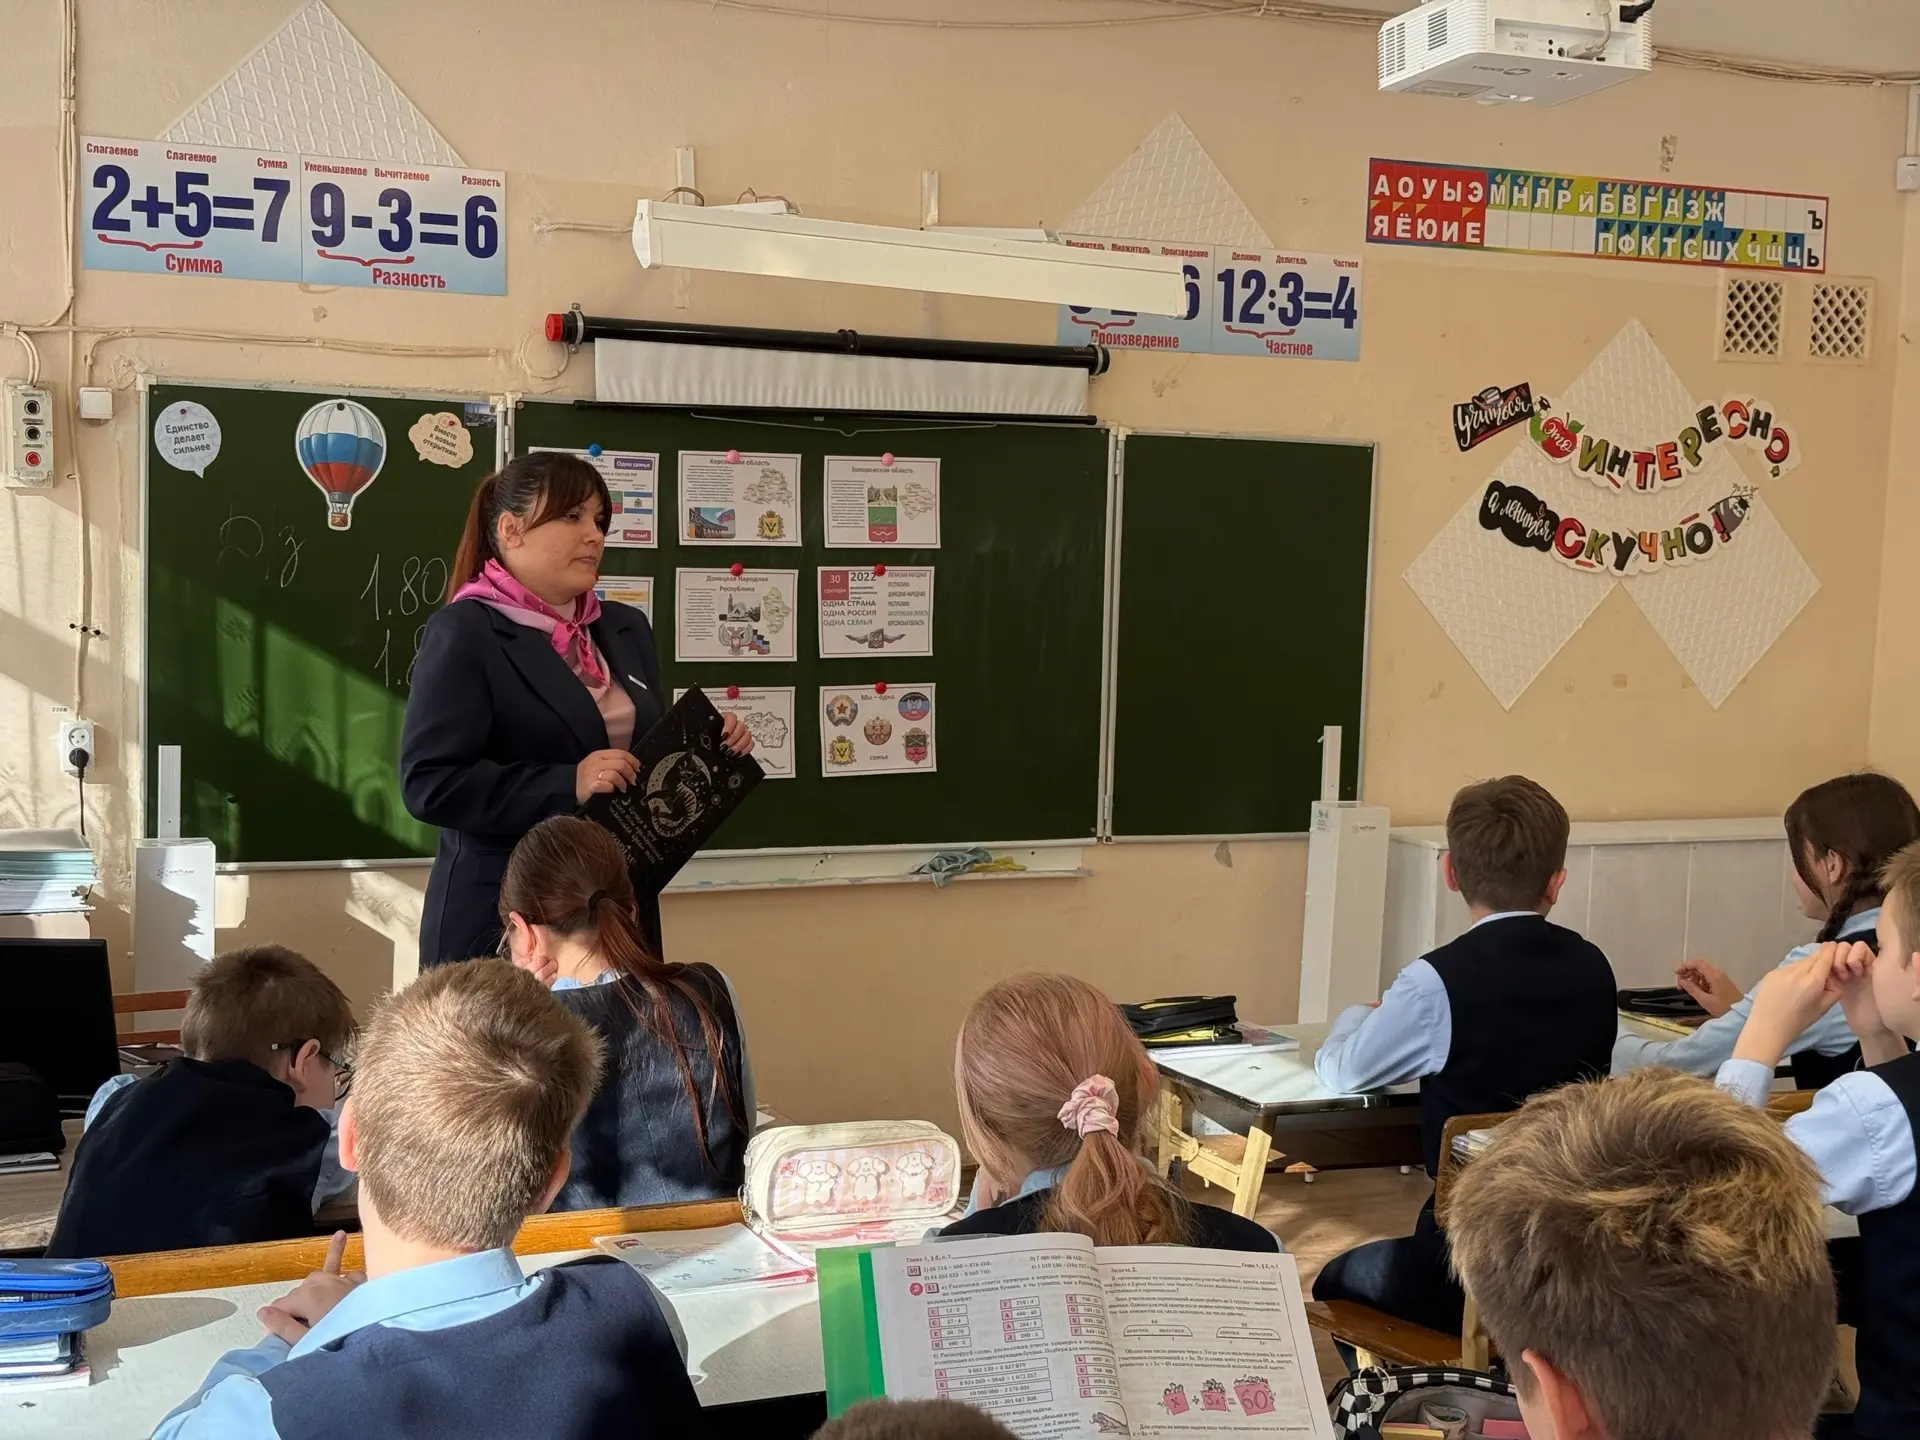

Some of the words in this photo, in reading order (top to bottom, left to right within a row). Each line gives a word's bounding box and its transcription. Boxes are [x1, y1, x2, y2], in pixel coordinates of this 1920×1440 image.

[87, 143, 139, 157] Слагаемое
[166, 149, 217, 164] Слагаемое
[257, 157, 288, 170] Сумма
[304, 161, 368, 177] Уменьшаемое
[374, 168, 430, 182] Вычитаемое
[462, 175, 501, 188] Разность
[92, 164, 291, 243] 2+5=7
[1111, 243, 1150, 254] Множитель
[1161, 247, 1208, 258] Произведение
[165, 253, 223, 274] Сумма
[1232, 252, 1261, 262] Делимое
[1276, 255, 1307, 266] Делитель
[1333, 259, 1359, 269] Частное
[373, 268, 446, 289] Разность
[1217, 268, 1357, 329] 12:3=4
[1091, 329, 1179, 349] Произведение
[1266, 339, 1313, 356] Частное
[165, 421, 210, 434] Единство
[434, 424, 458, 440] Вместе
[173, 432, 206, 445] делает
[1578, 400, 1790, 490] ИНТЕРЕСНО
[173, 442, 211, 455] сильнее
[422, 438, 458, 458] открытиям
[616, 461, 632, 469] Одна
[1554, 510, 1732, 572] СКУЧНО!
[706, 575, 737, 583] Донецкая
[738, 575, 768, 583] Народная
[830, 575, 841, 584] 30
[850, 572, 877, 582] 2022
[823, 600, 845, 608] ОДНА
[1241, 1389, 1268, 1410] 60
